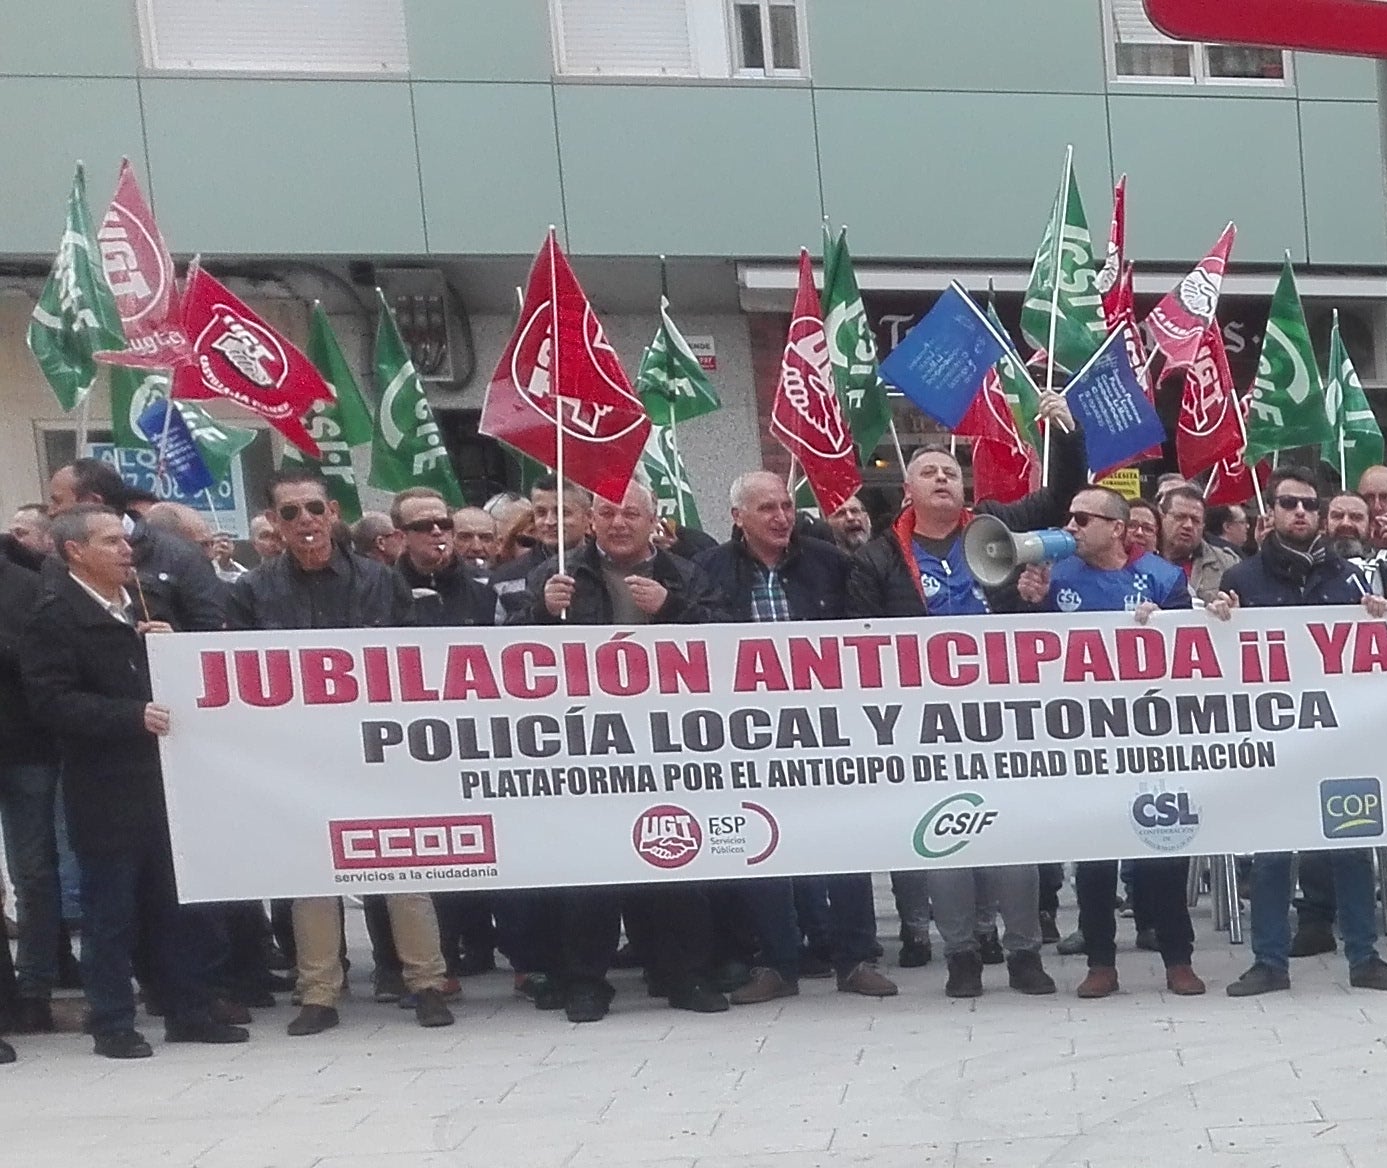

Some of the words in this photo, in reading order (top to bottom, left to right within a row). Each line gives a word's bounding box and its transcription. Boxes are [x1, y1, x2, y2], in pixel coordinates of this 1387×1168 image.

[196, 631, 709, 708] JUBILACIÓN
[733, 627, 1222, 693] ANTICIPADA
[362, 705, 633, 763] POLICÍA
[649, 705, 851, 753] LOCAL
[864, 703, 903, 747] Y
[919, 688, 1338, 744] AUTONÓMICA
[461, 762, 657, 799] PLATAFORMA
[664, 761, 723, 792] POR
[731, 760, 761, 789] EL
[767, 755, 905, 788] ANTICIPO
[913, 753, 948, 782] DE
[954, 752, 990, 780] LA
[995, 748, 1067, 779] EDAD
[1075, 747, 1110, 776] DE
[1115, 737, 1276, 774] JUBILACIÓN
[1132, 792, 1199, 828] CSL
[1327, 794, 1380, 819] COP
[641, 815, 691, 842] UGT
[934, 811, 998, 836] CSIF
[341, 825, 485, 859] CCOO
[710, 836, 746, 846] Servicios
[711, 845, 745, 854] Públicos
[335, 871, 394, 883] servicios
[399, 871, 407, 880] a
[410, 870, 423, 880] la
[425, 867, 498, 880] ciudadanía
